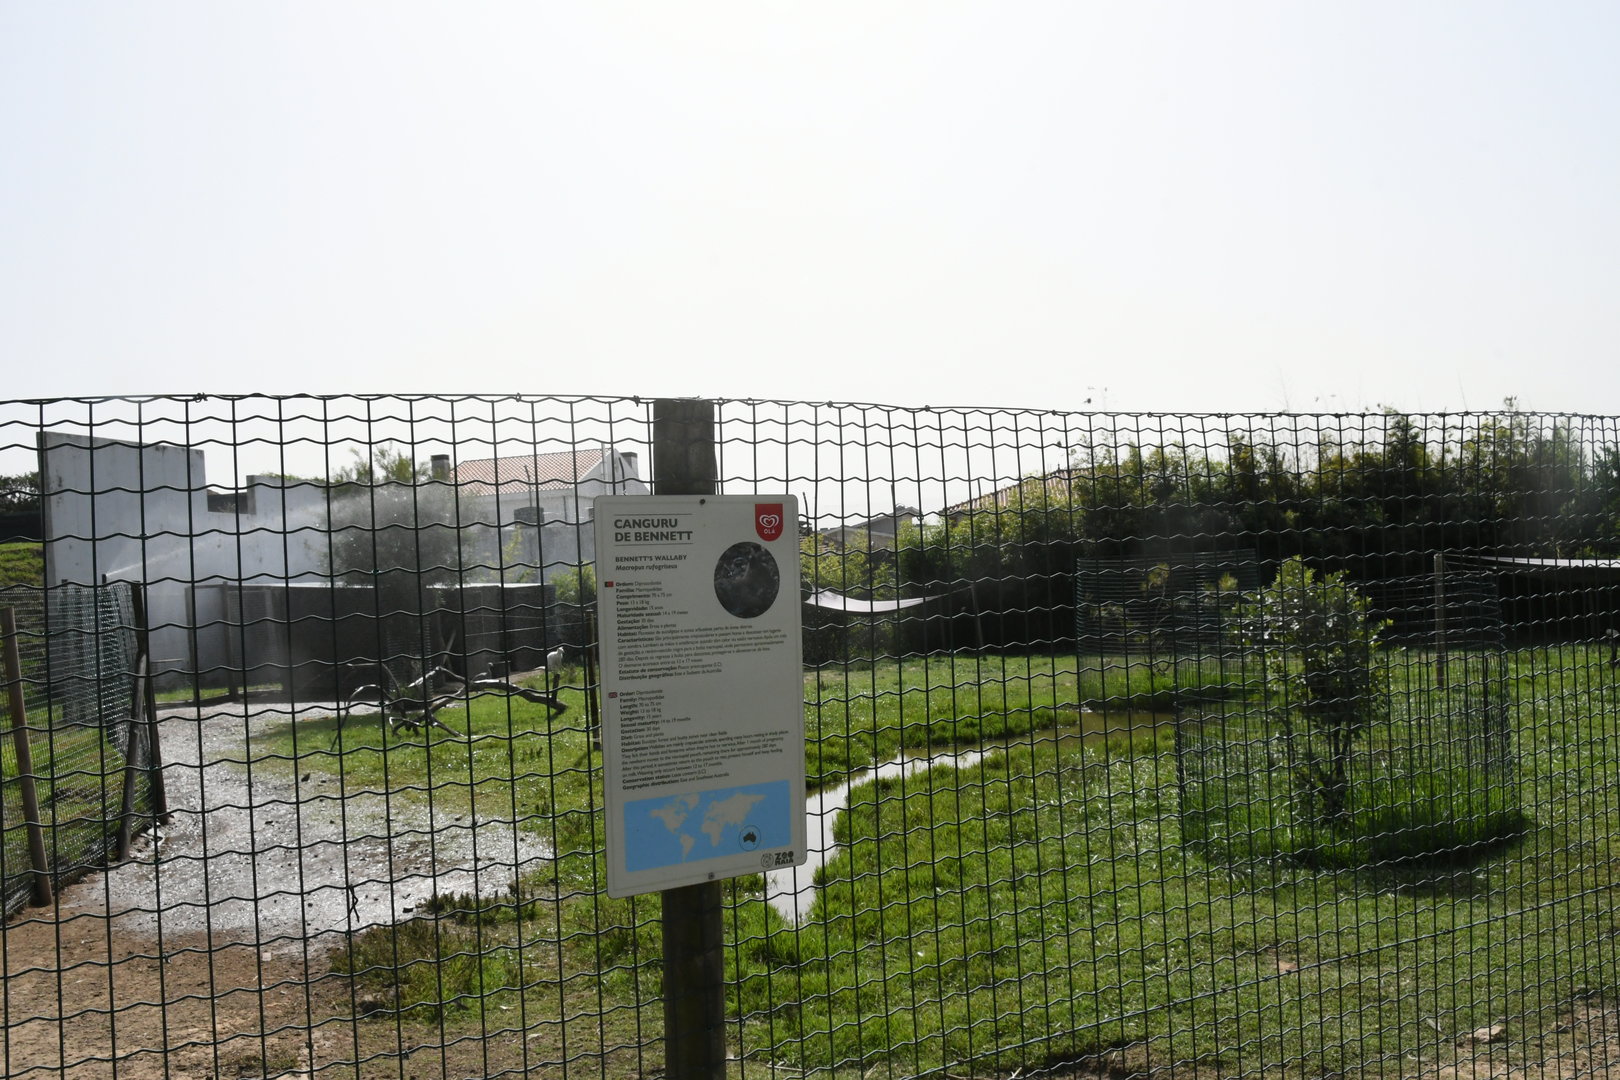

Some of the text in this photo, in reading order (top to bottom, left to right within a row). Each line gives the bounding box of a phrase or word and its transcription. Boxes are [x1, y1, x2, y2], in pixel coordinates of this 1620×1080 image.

[614, 518, 678, 530] CANGURU
[614, 530, 694, 542] DE BENNETT
[774, 851, 794, 860] ZOO
